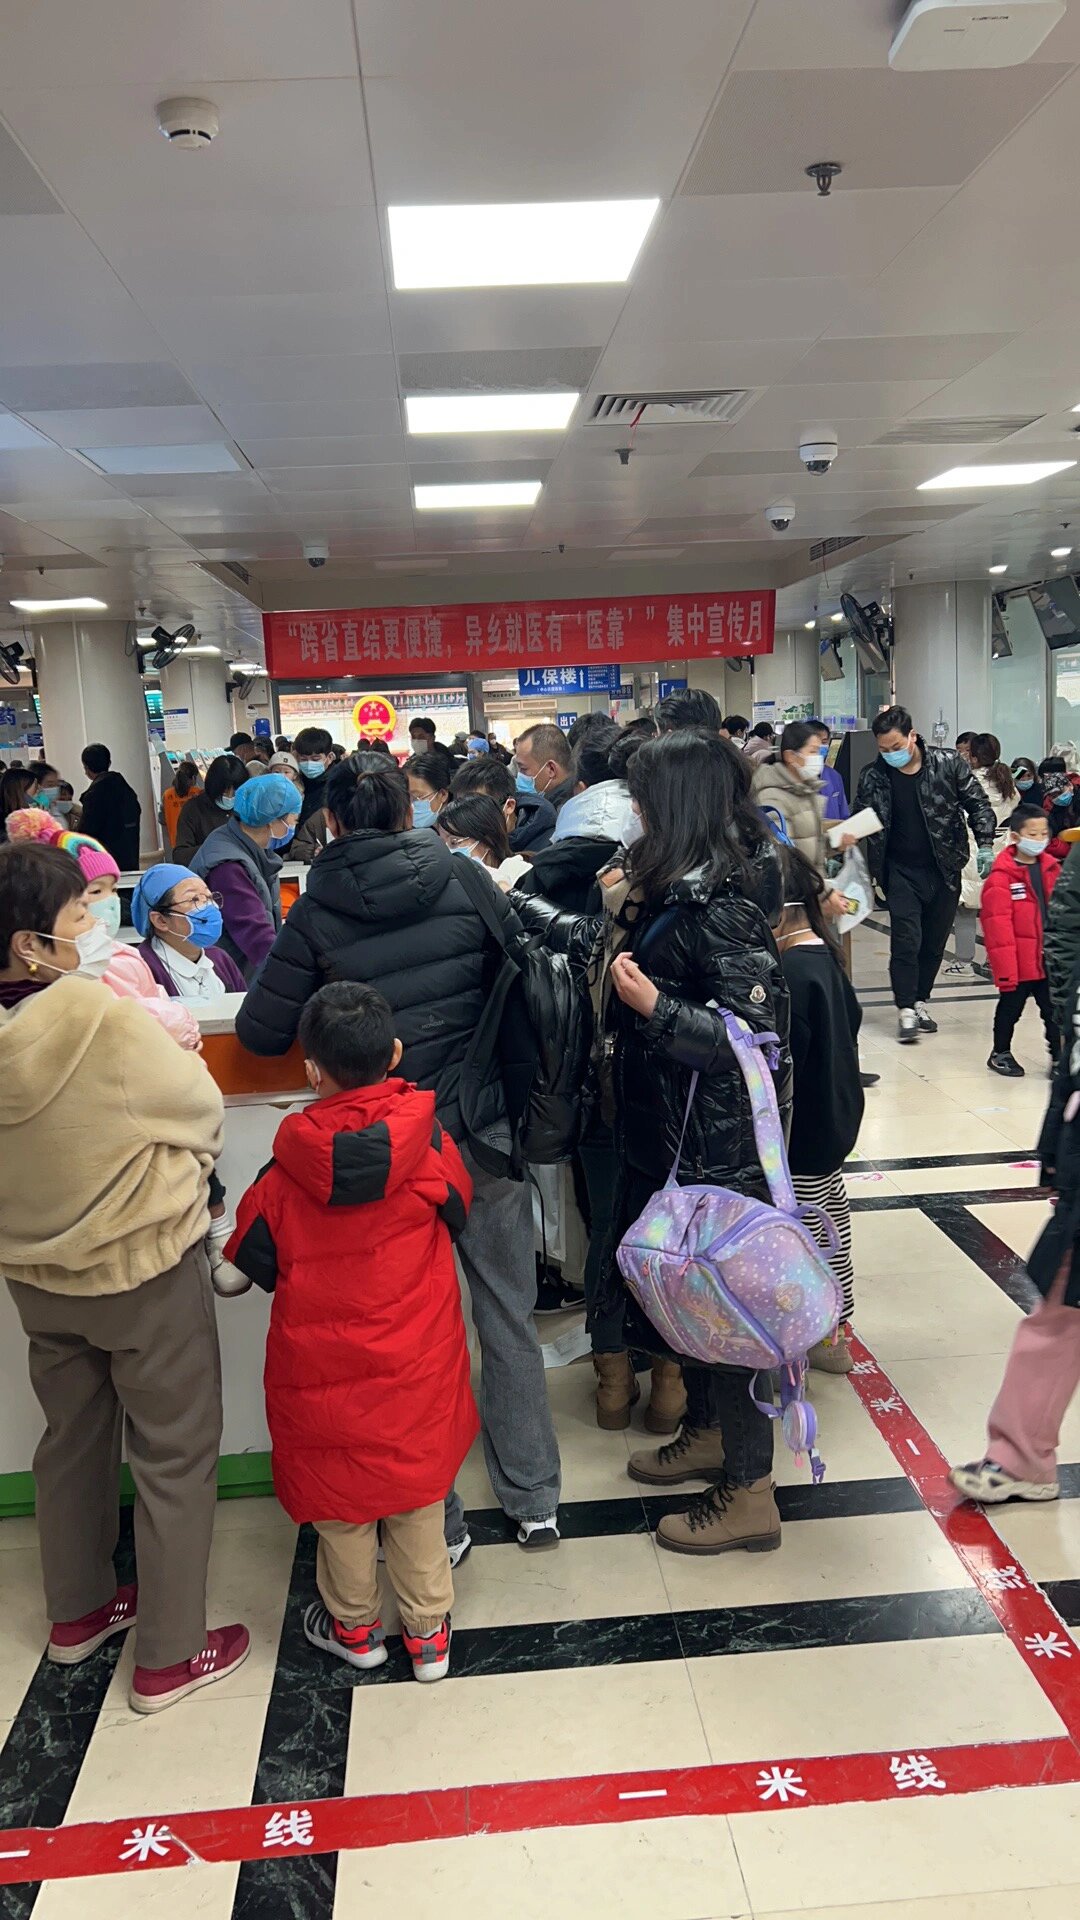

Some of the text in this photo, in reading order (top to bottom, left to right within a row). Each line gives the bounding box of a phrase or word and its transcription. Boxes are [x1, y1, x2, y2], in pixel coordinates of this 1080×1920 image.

[523, 667, 577, 686] 儿保楼
[619, 1755, 946, 1801] 一米线
